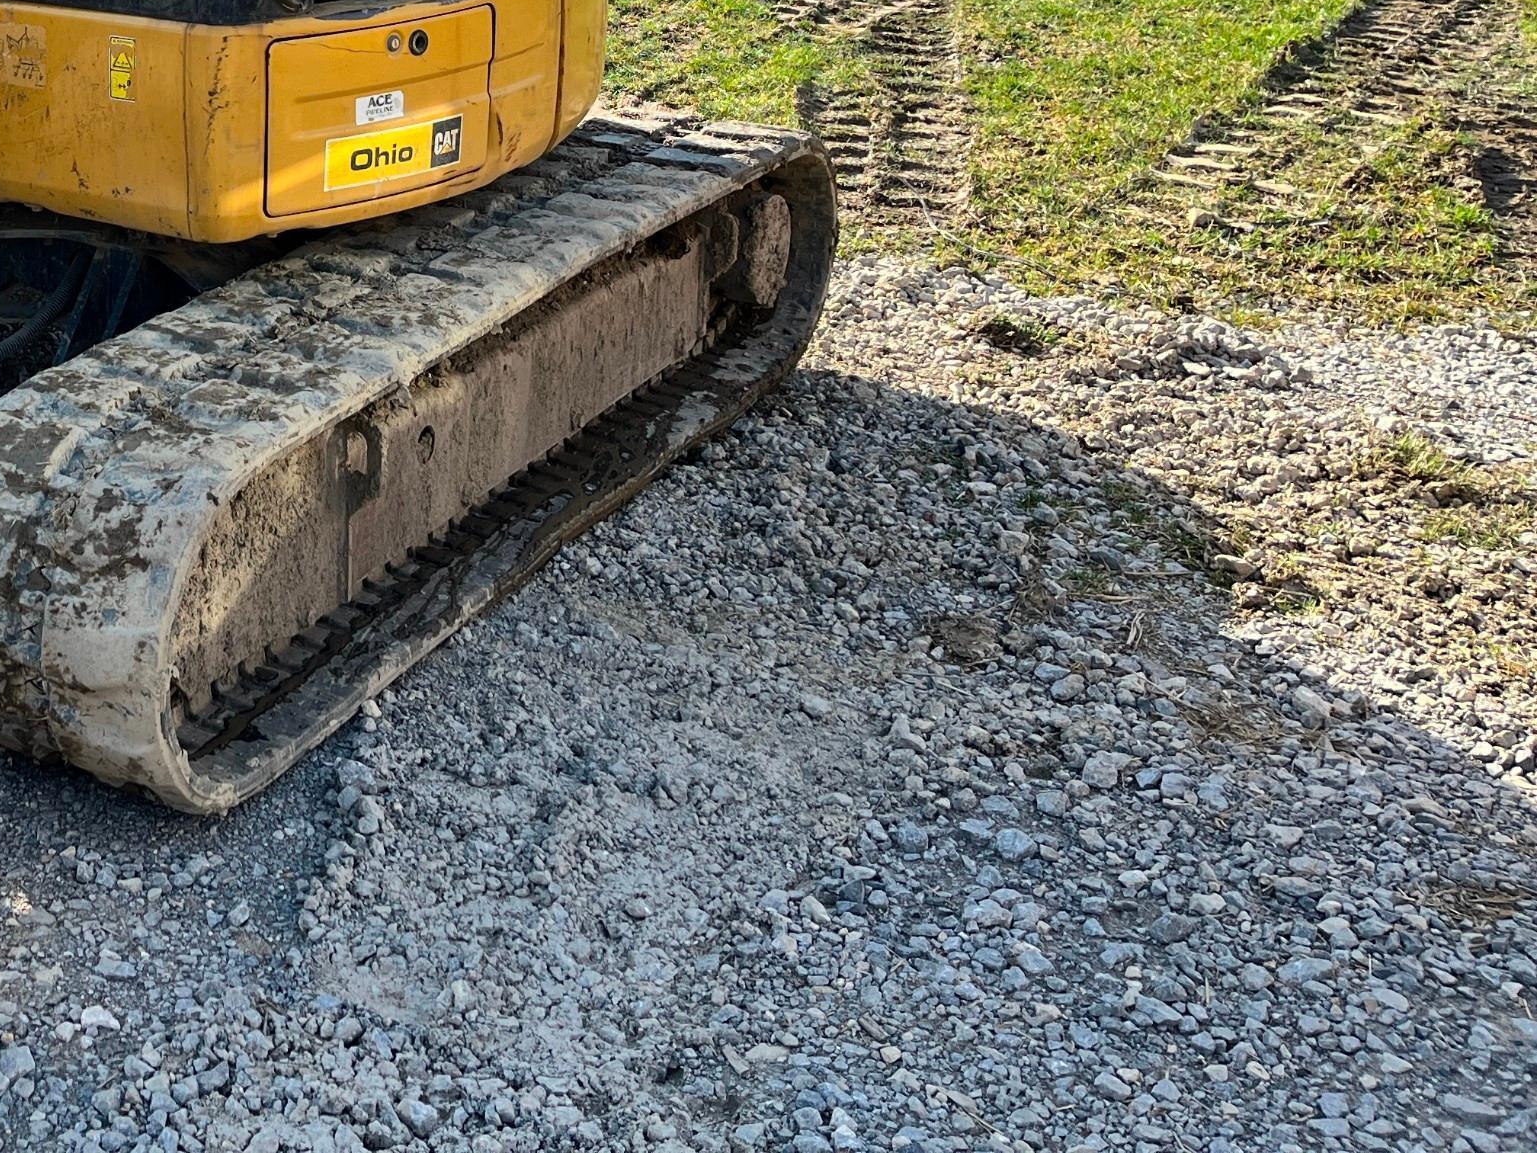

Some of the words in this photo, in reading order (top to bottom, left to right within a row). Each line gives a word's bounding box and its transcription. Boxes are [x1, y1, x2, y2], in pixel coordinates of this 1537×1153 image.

[368, 94, 392, 108] ACE
[350, 143, 413, 171] Ohio
[434, 128, 459, 156] CAT
